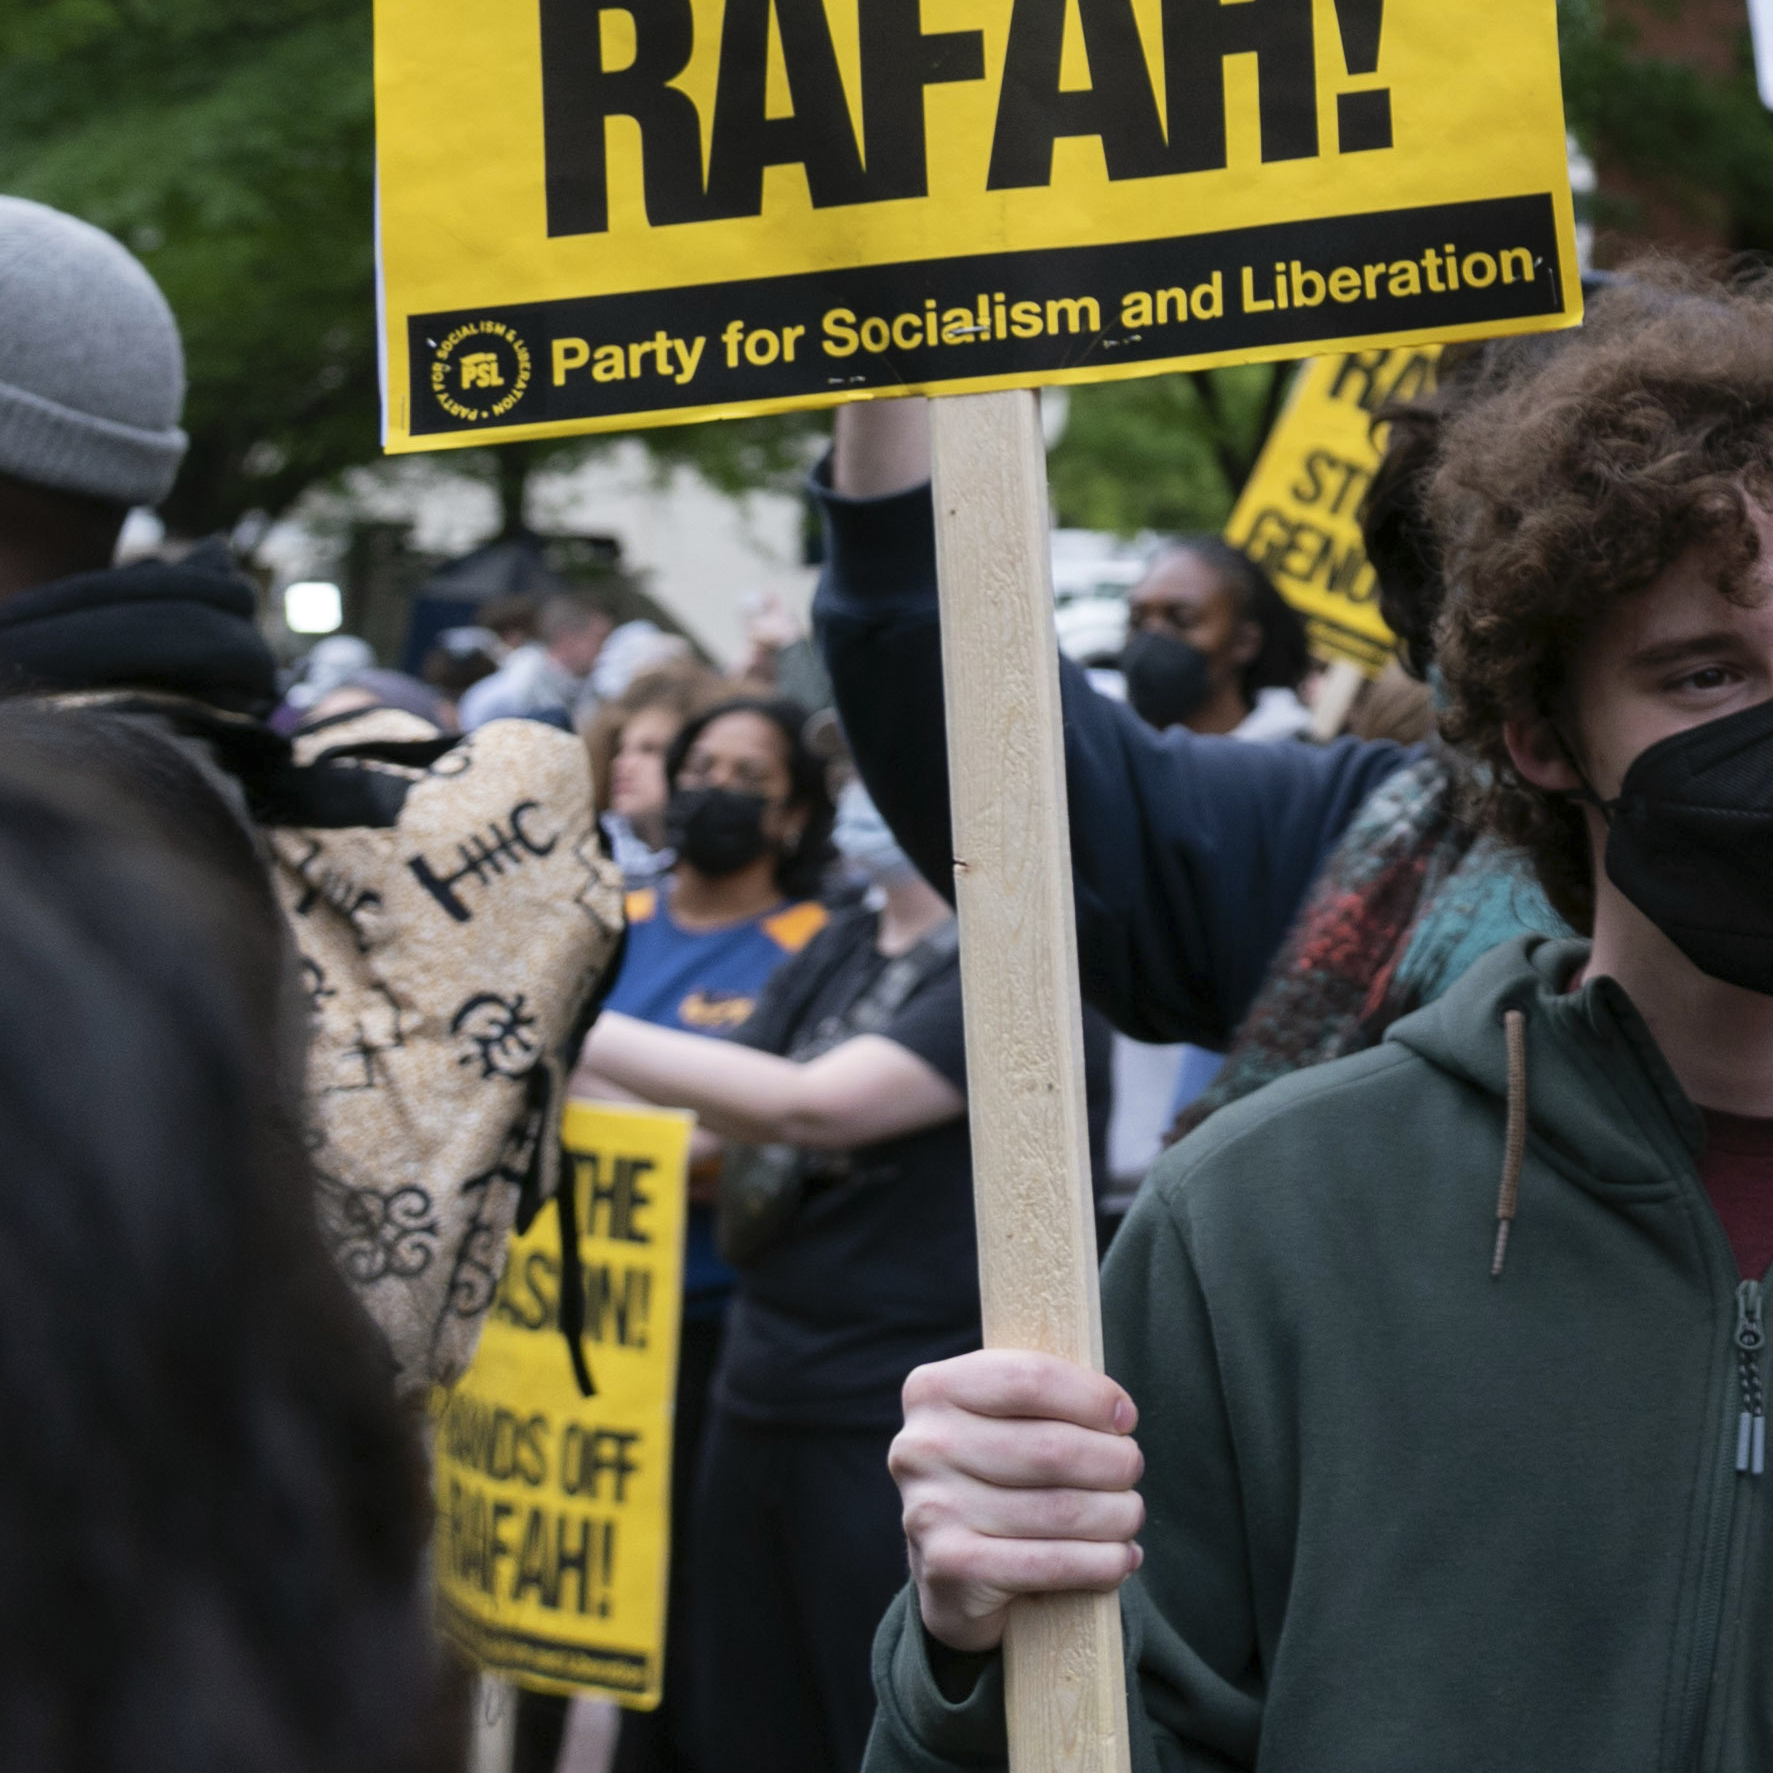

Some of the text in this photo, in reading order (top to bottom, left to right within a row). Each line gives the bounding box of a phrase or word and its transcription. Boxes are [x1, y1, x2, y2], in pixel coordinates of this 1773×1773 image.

[436, 320, 507, 360] SOCIALISM
[550, 244, 1536, 386] Party for Socialism and Liberation
[460, 362, 504, 390] PSL
[492, 339, 531, 416] LIBERATION
[436, 393, 479, 421] PARTY
[560, 1421, 642, 1504] OFF
